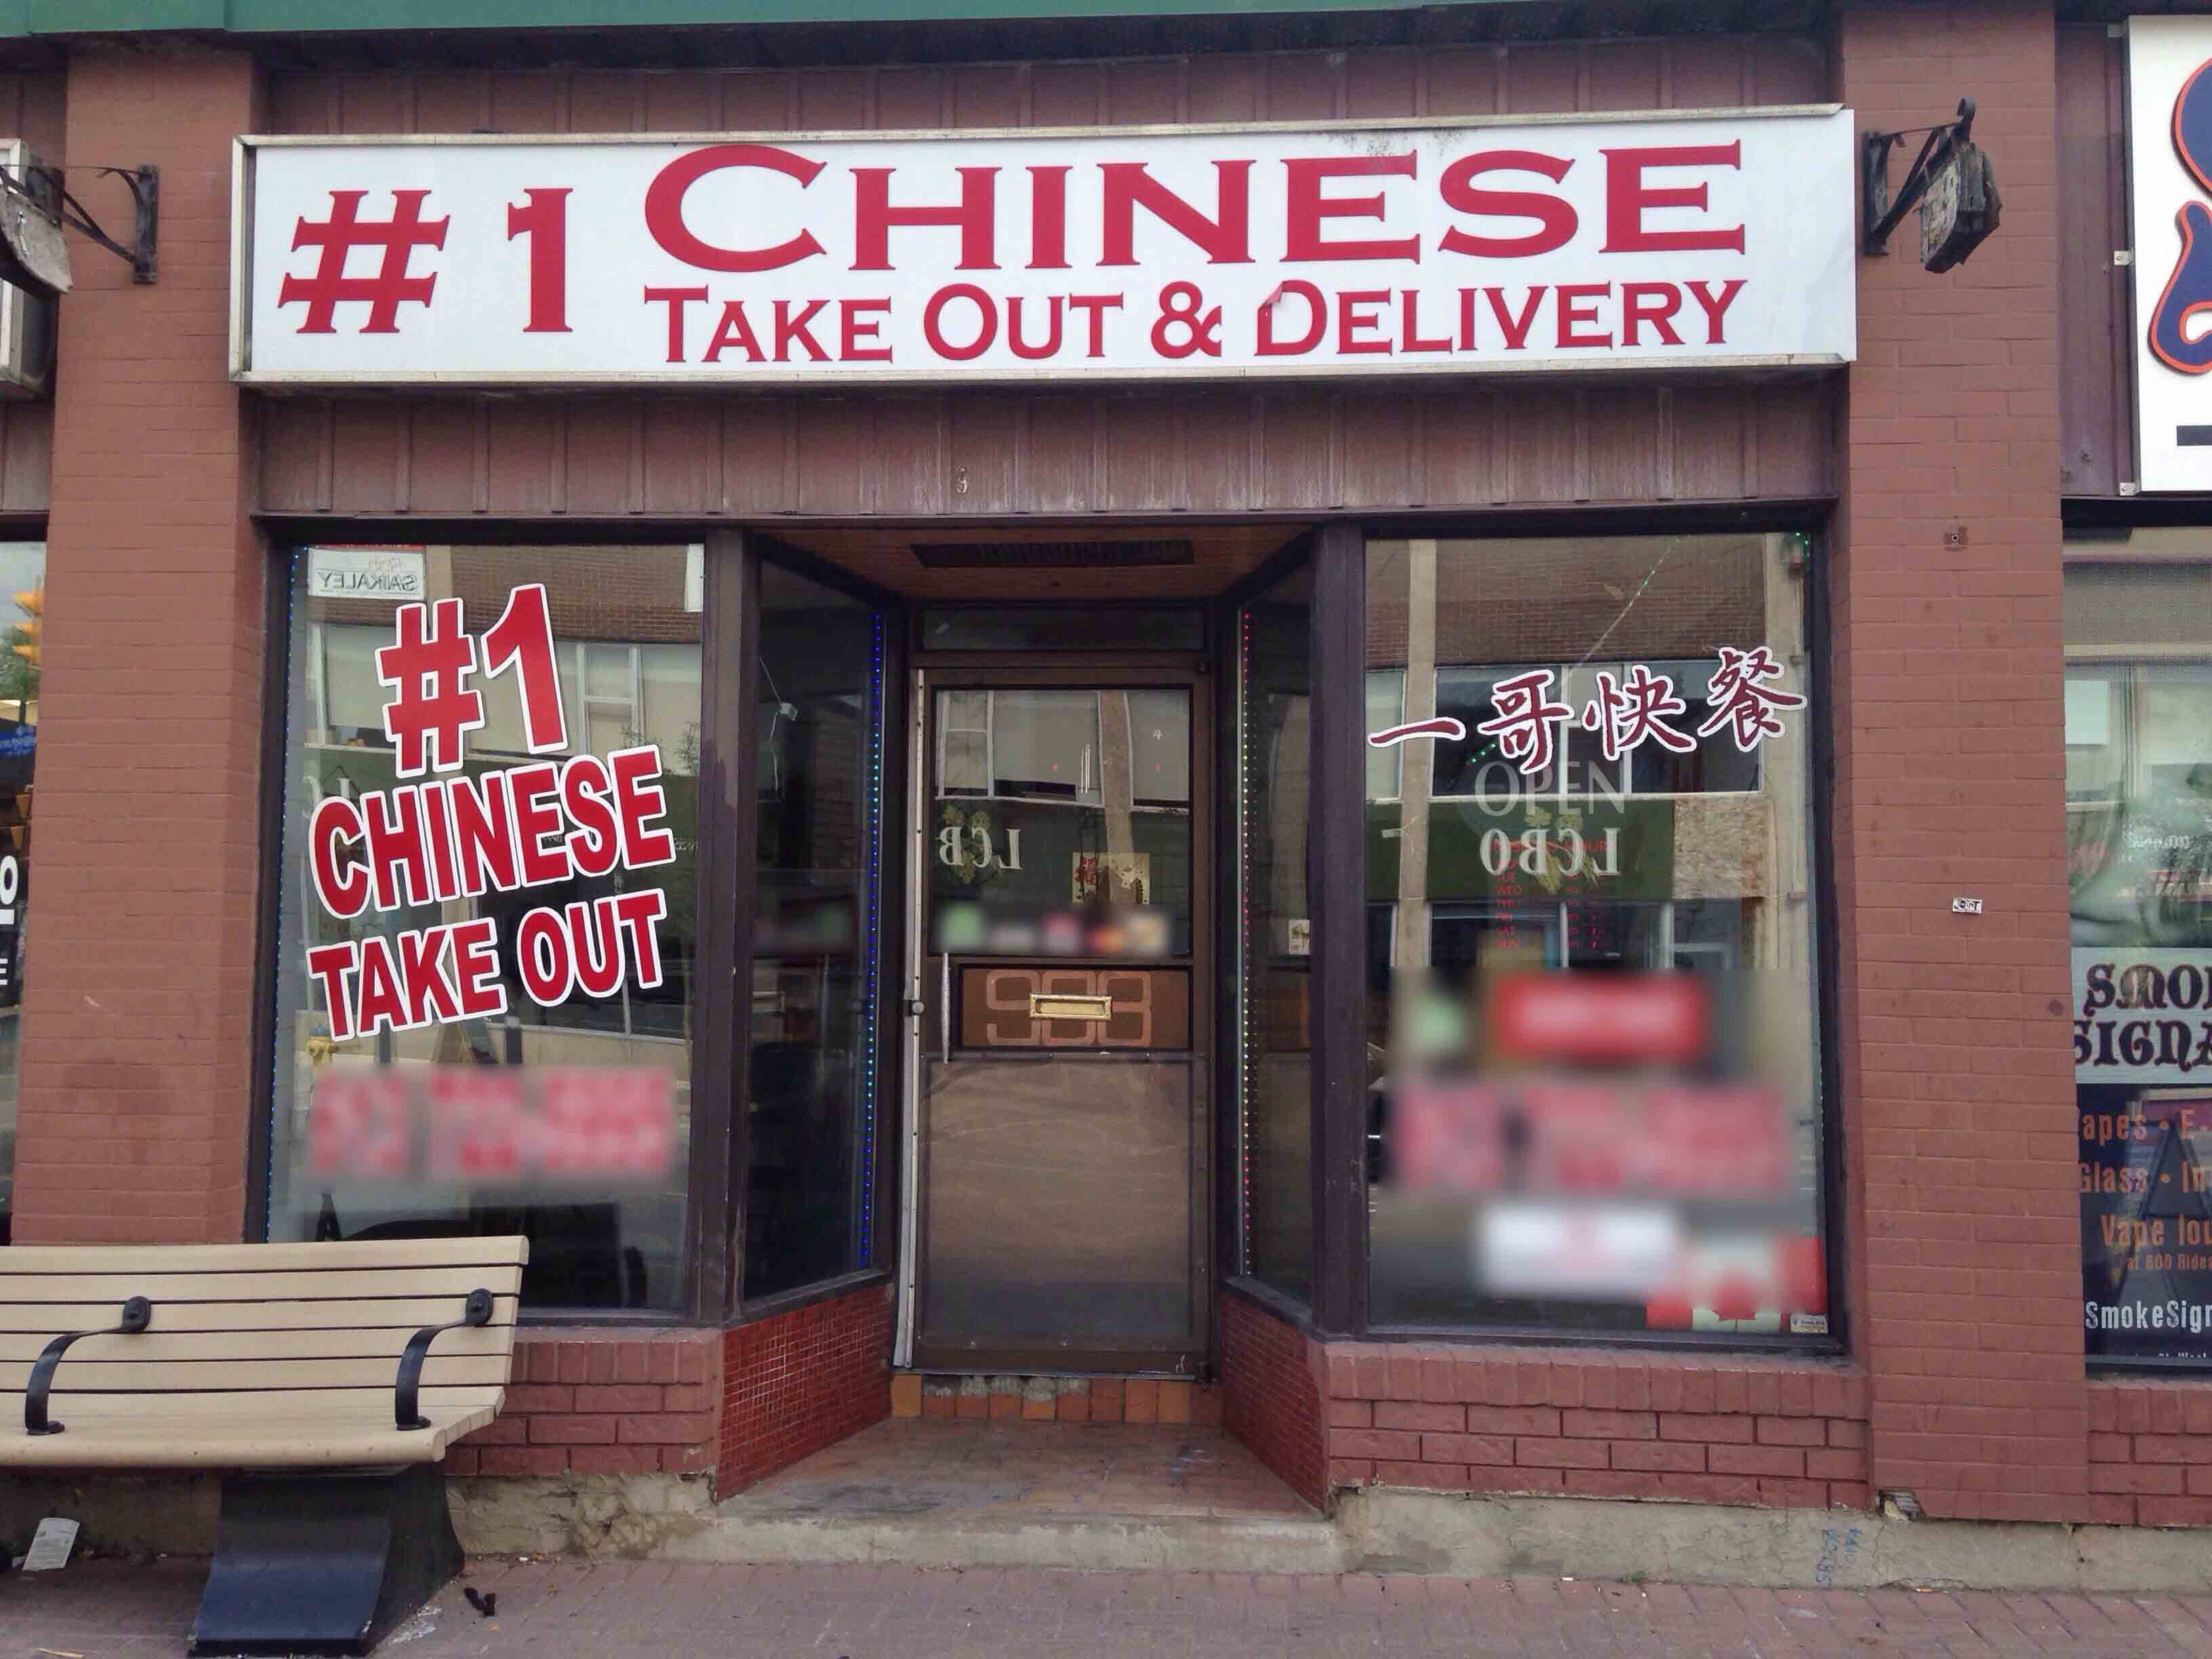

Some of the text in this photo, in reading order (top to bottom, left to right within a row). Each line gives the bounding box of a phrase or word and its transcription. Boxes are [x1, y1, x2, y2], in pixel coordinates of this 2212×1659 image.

[644, 139, 1746, 272] CHINESE
[644, 283, 893, 364] TAKE
[923, 283, 1124, 361] OUT
[1254, 279, 1748, 357] DELIVERY
[375, 583, 568, 777] #1
[1368, 647, 1808, 775] 一哥快餐
[309, 745, 675, 920] CHINESE
[1474, 760, 1625, 817] OPEN
[306, 888, 667, 1041] TAKE OUT
[2083, 963, 2212, 1016] SMO
[2078, 1113, 2148, 1146] apes
[2102, 1214, 2164, 1252] Vape
